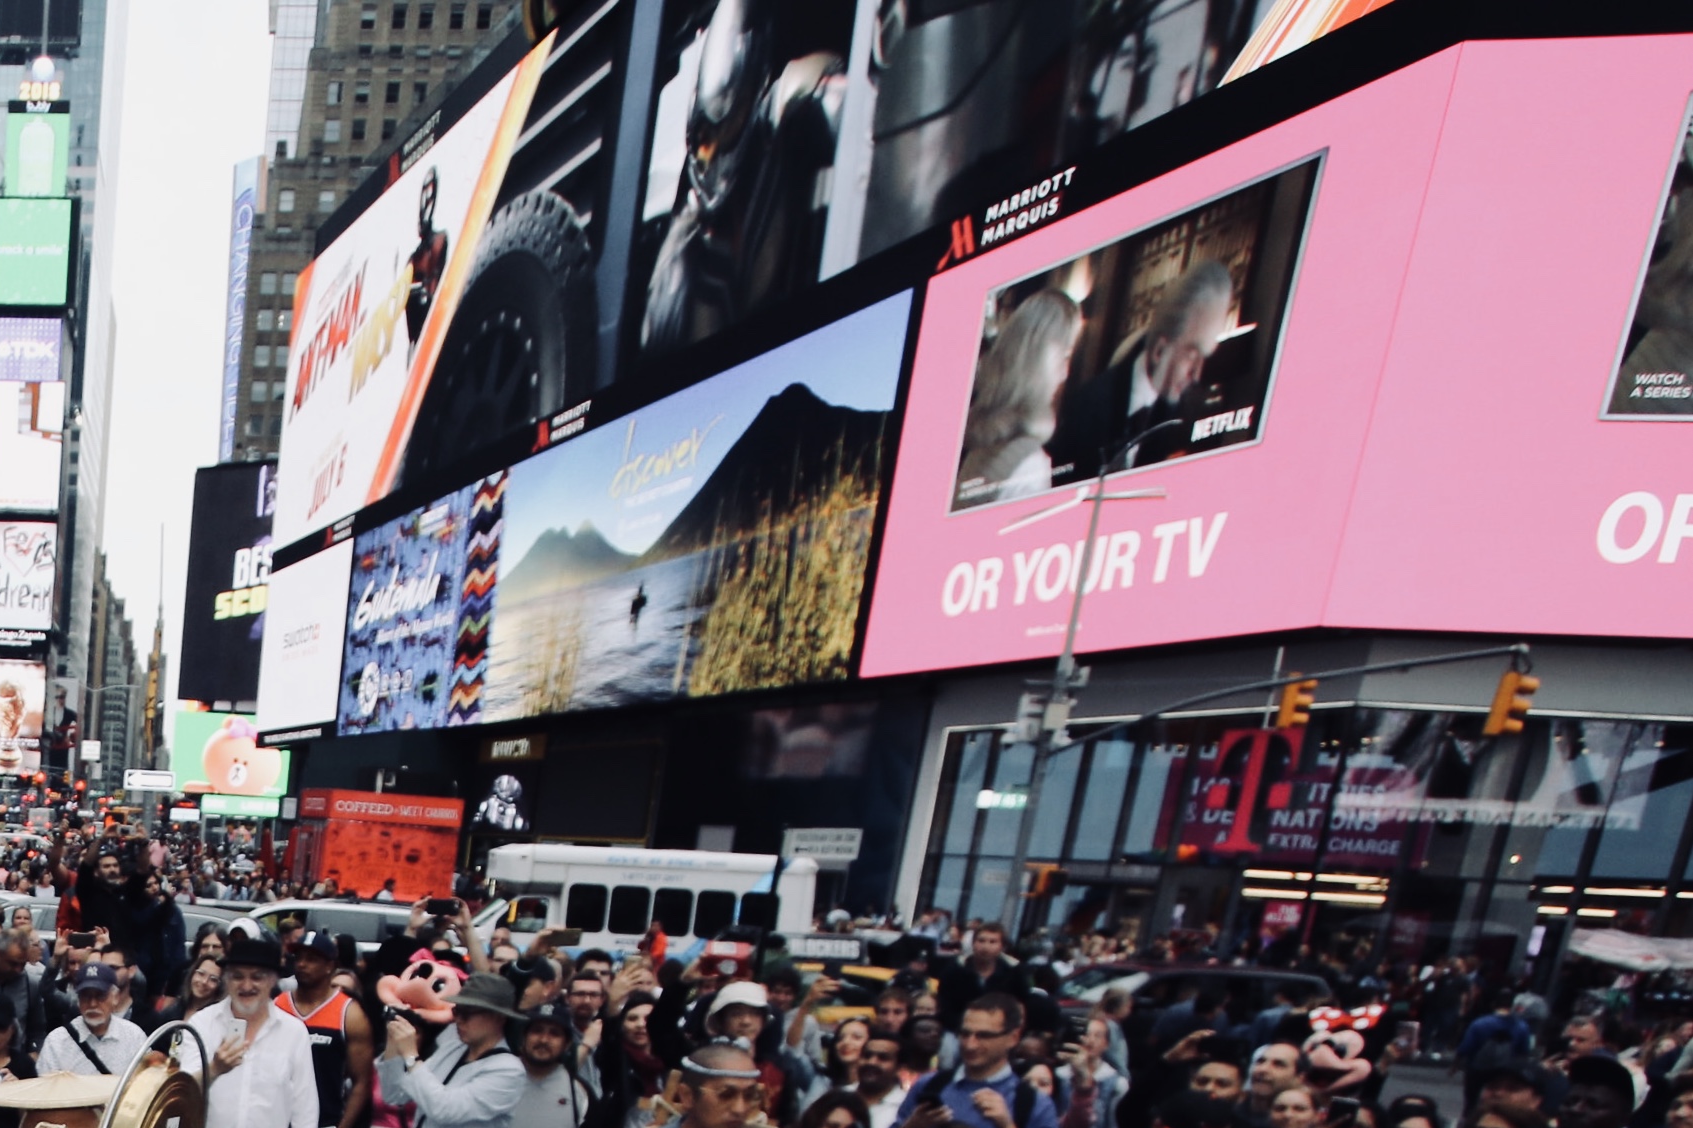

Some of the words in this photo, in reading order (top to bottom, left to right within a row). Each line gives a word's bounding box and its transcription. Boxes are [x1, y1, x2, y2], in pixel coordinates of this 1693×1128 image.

[19, 80, 61, 101] 2018
[984, 166, 1077, 223] MARRIOTT
[980, 197, 1060, 246] MARQUIS
[229, 203, 254, 365] CHANGING
[10, 341, 57, 360] TDK
[1634, 372, 1686, 385] WATCH
[1629, 386, 1643, 398] A
[1644, 386, 1692, 399] SERIES
[1190, 405, 1255, 443] NETFLIX
[941, 556, 1004, 618] OR
[1012, 529, 1142, 606] YOUR
[1152, 511, 1230, 584] TV
[334, 799, 394, 817] COFFEED
[1328, 836, 1402, 856] CHARGE
